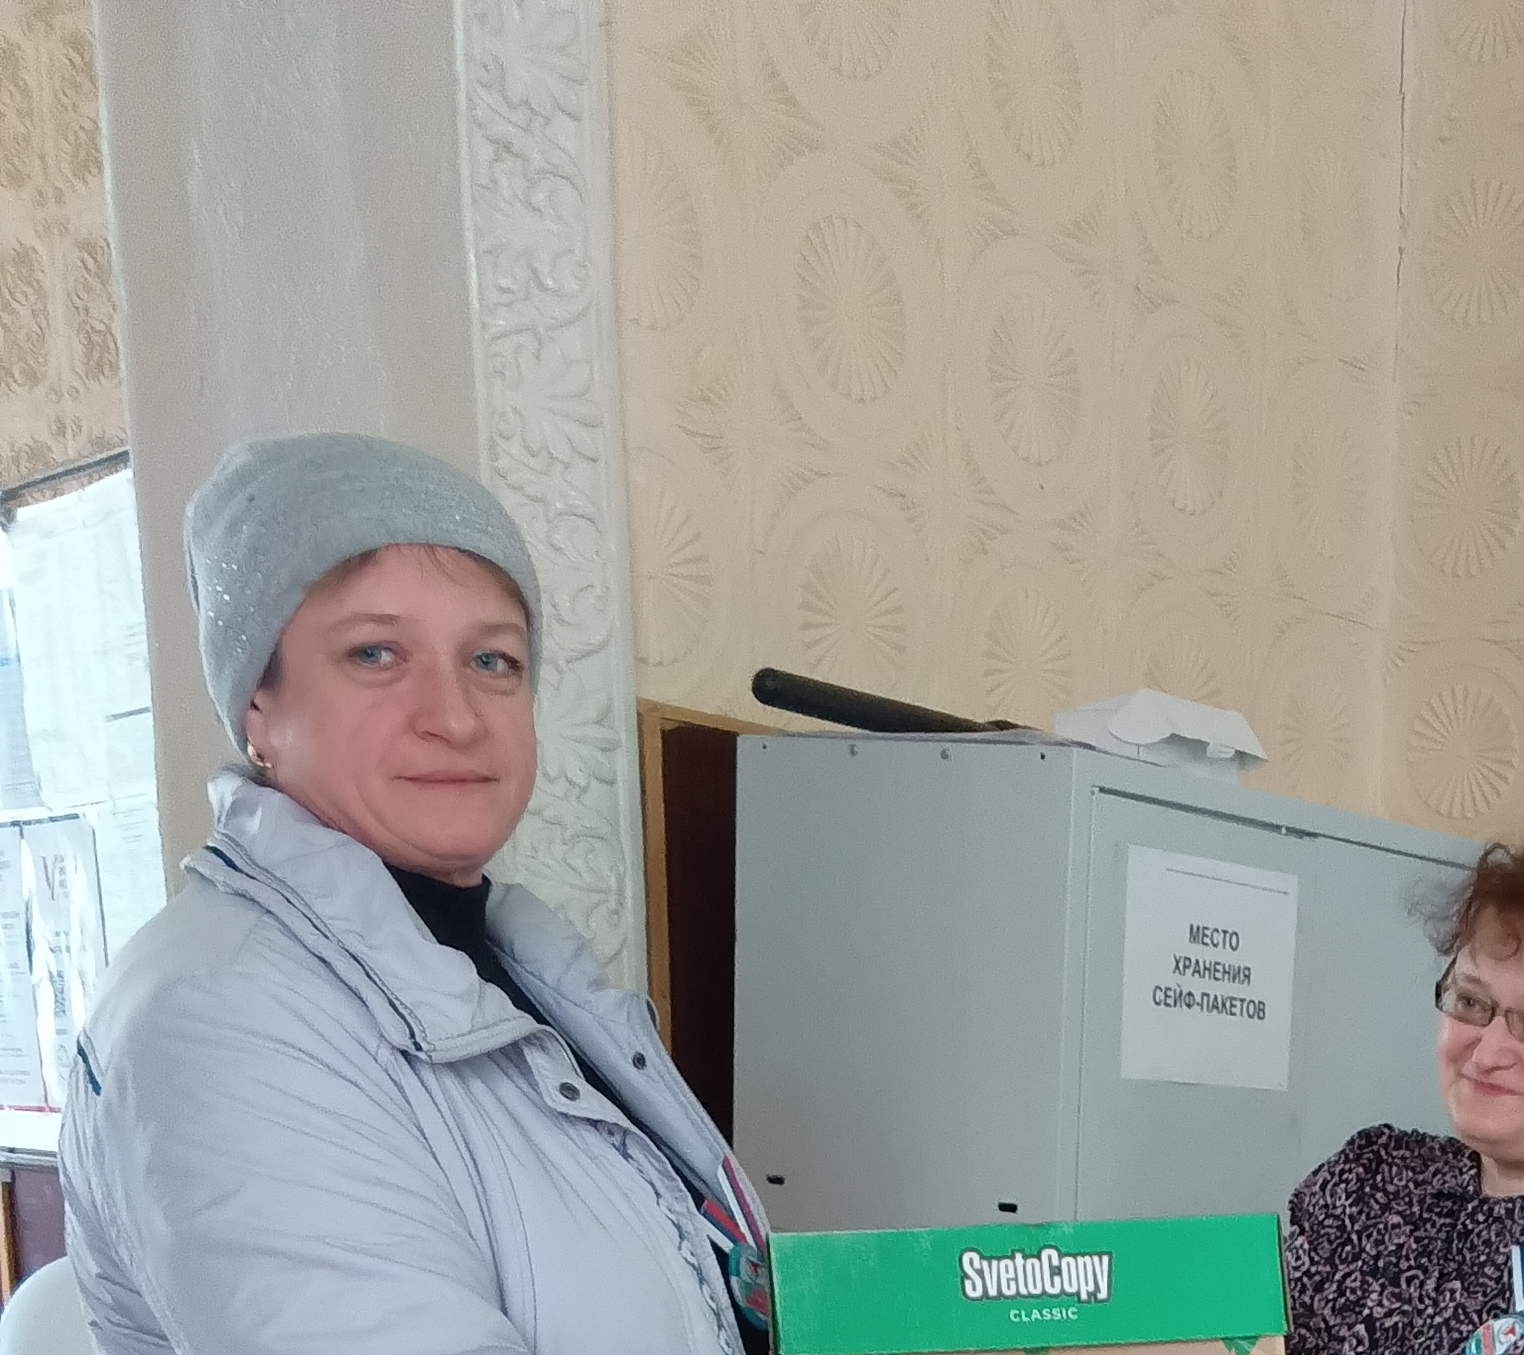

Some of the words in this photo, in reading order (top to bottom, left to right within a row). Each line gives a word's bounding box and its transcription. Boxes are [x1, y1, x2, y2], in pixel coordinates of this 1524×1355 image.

[1188, 923, 1240, 951] МЕСТО
[1172, 953, 1252, 986] ХРАНЕНИЯ
[1152, 983, 1267, 1021] СЕЙФ-ПАКЕТОВ
[961, 1247, 1112, 1303] SvetoCopy
[1009, 1307, 1079, 1323] CLASSIC
